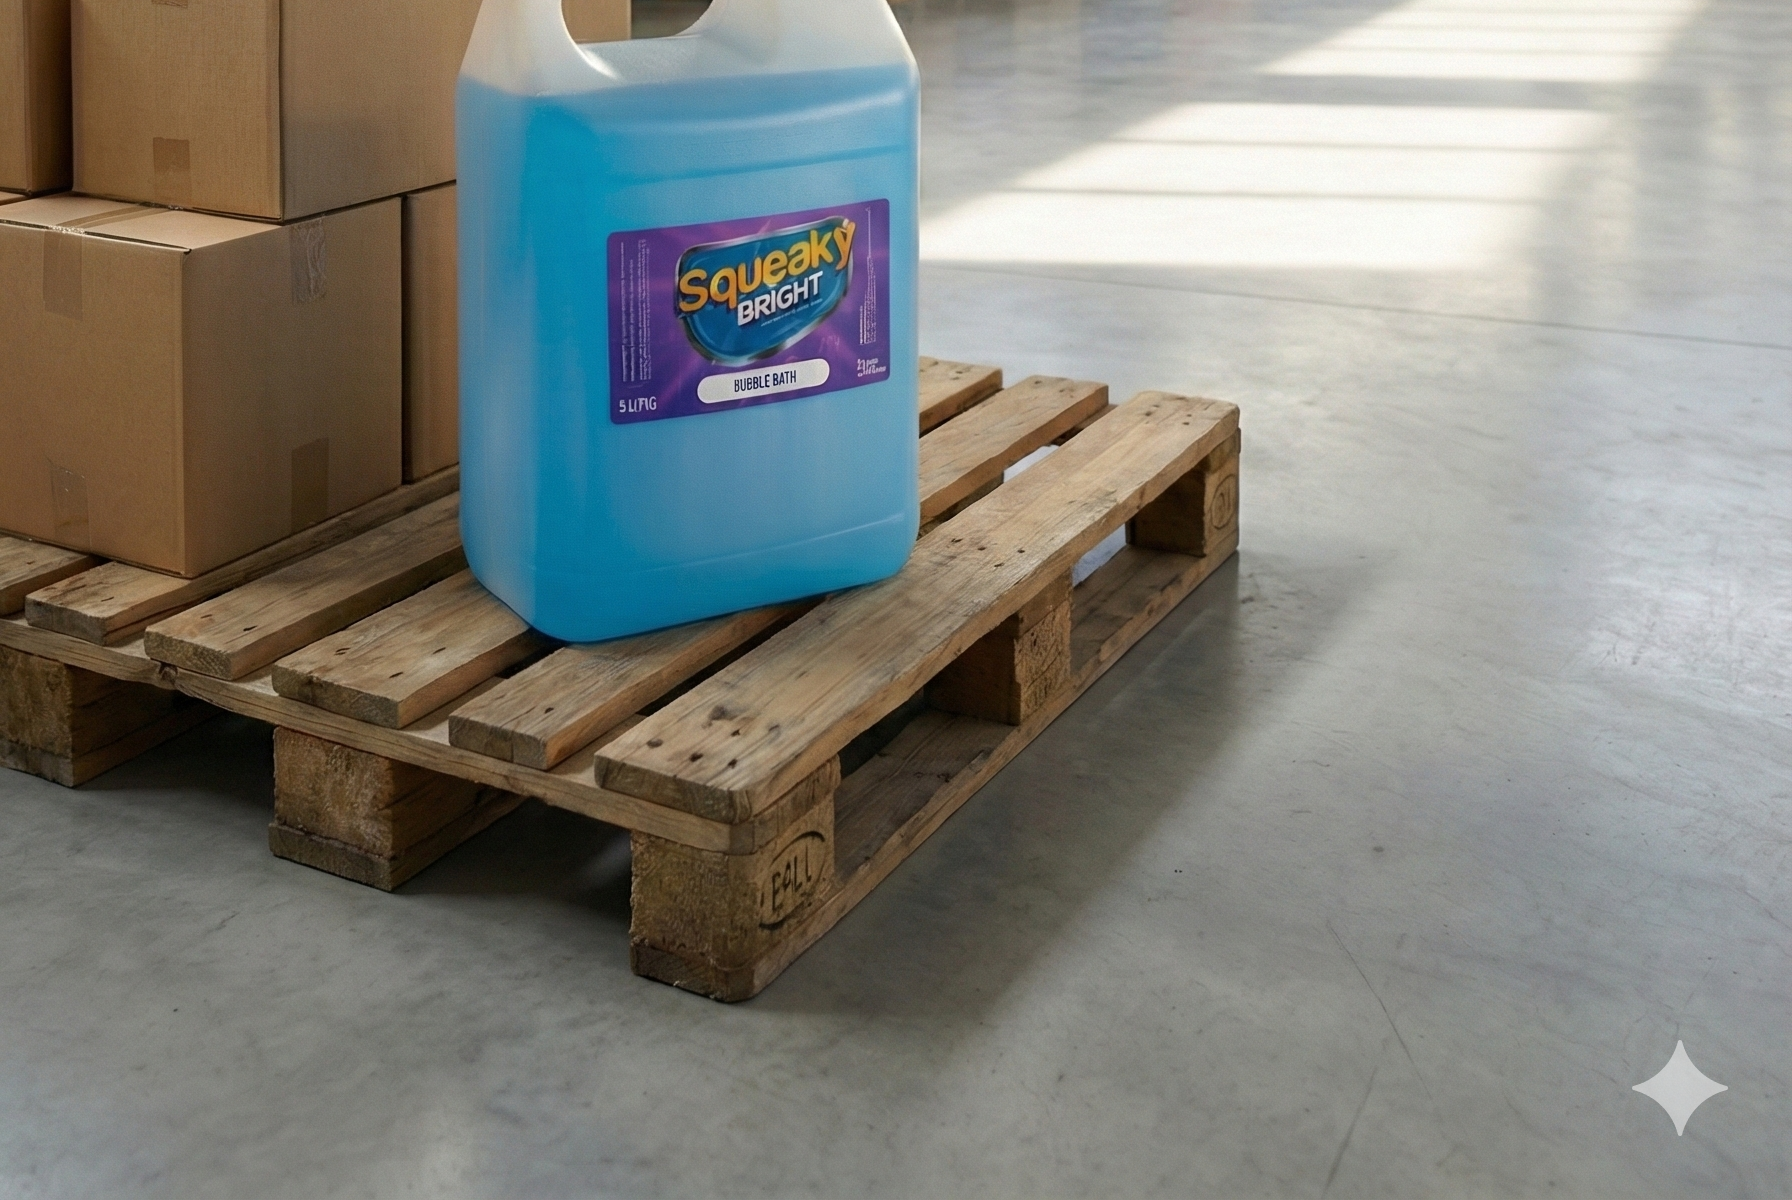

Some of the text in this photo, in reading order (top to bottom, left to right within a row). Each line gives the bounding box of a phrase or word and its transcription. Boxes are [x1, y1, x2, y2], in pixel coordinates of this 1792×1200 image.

[678, 221, 856, 313] Squeaky
[737, 270, 824, 326] BRIGHT
[734, 369, 797, 393] BUBBLE BATH
[619, 399, 626, 413] 5
